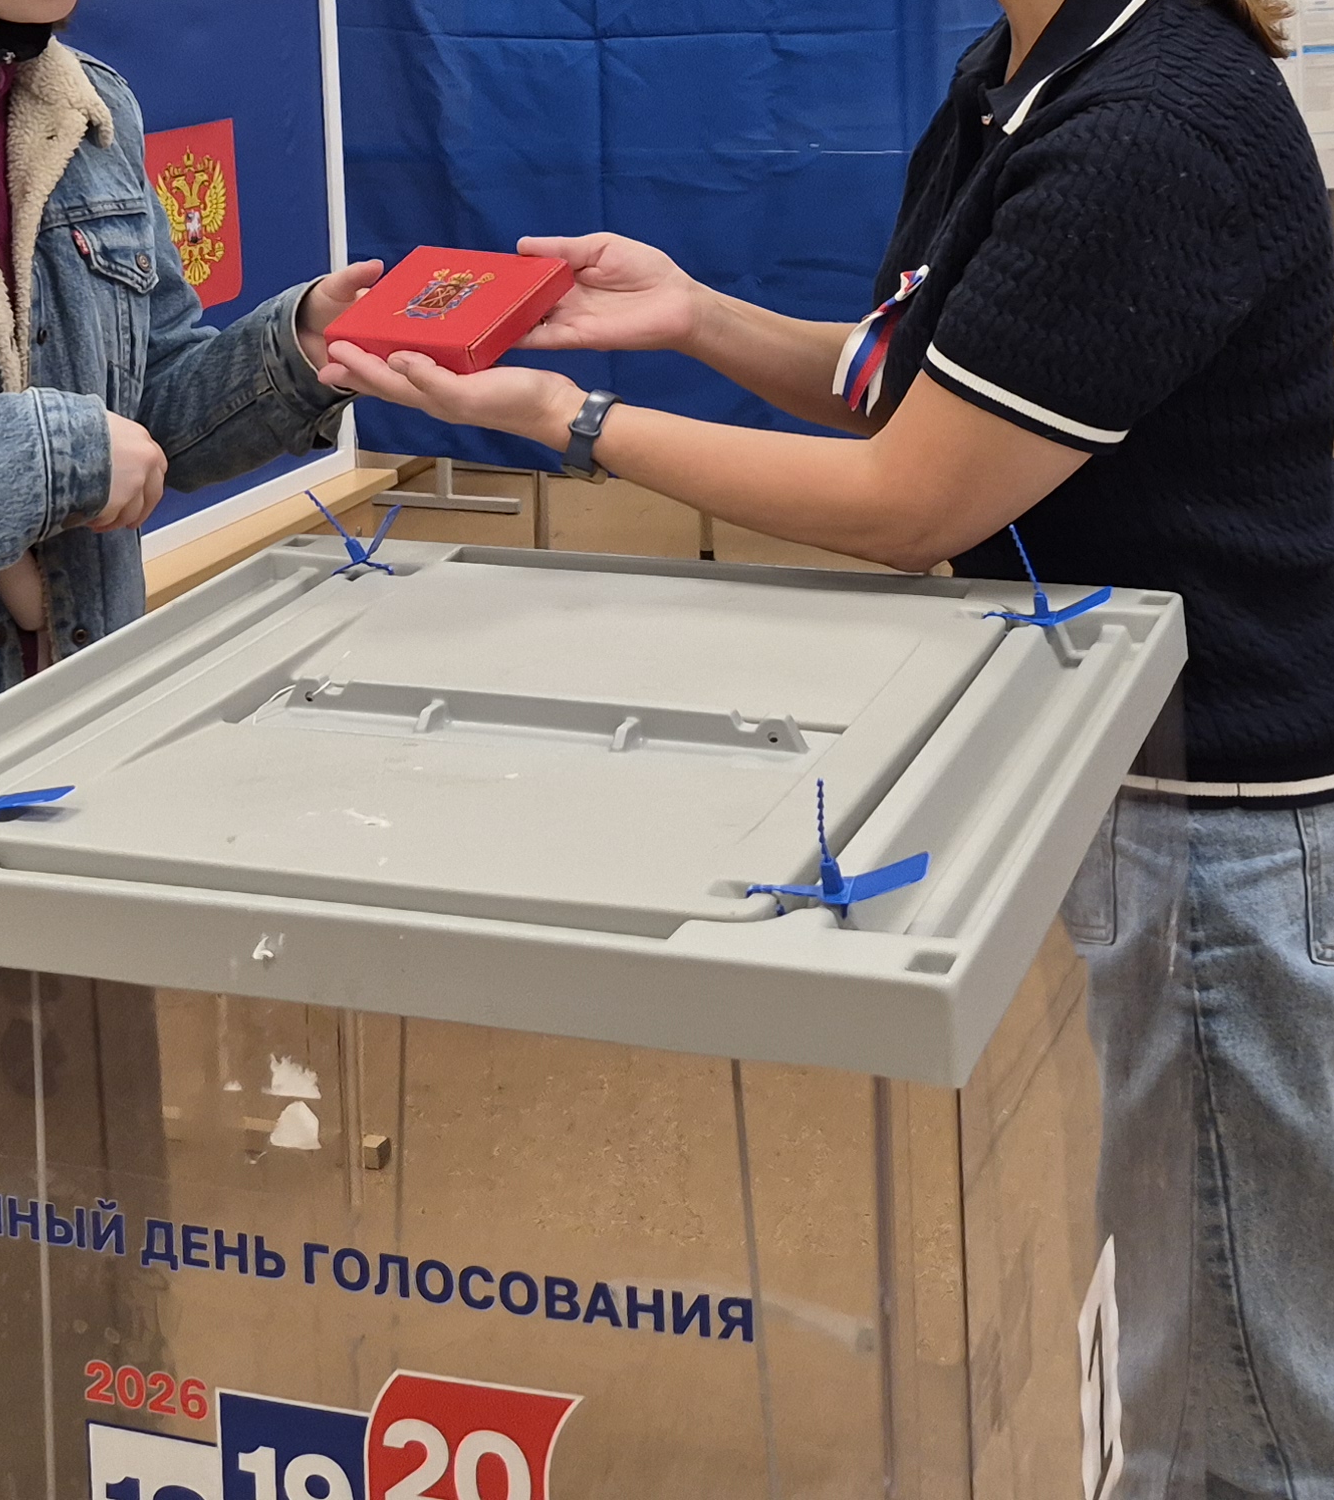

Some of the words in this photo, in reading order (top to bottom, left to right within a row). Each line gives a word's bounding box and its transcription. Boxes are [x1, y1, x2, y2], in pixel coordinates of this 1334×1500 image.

[141, 1216, 287, 1280] ДЕНЬ
[303, 1241, 754, 1343] ГОЛОСОВАНИЯ
[84, 1359, 210, 1421] 2026
[382, 1418, 532, 1500] 20
